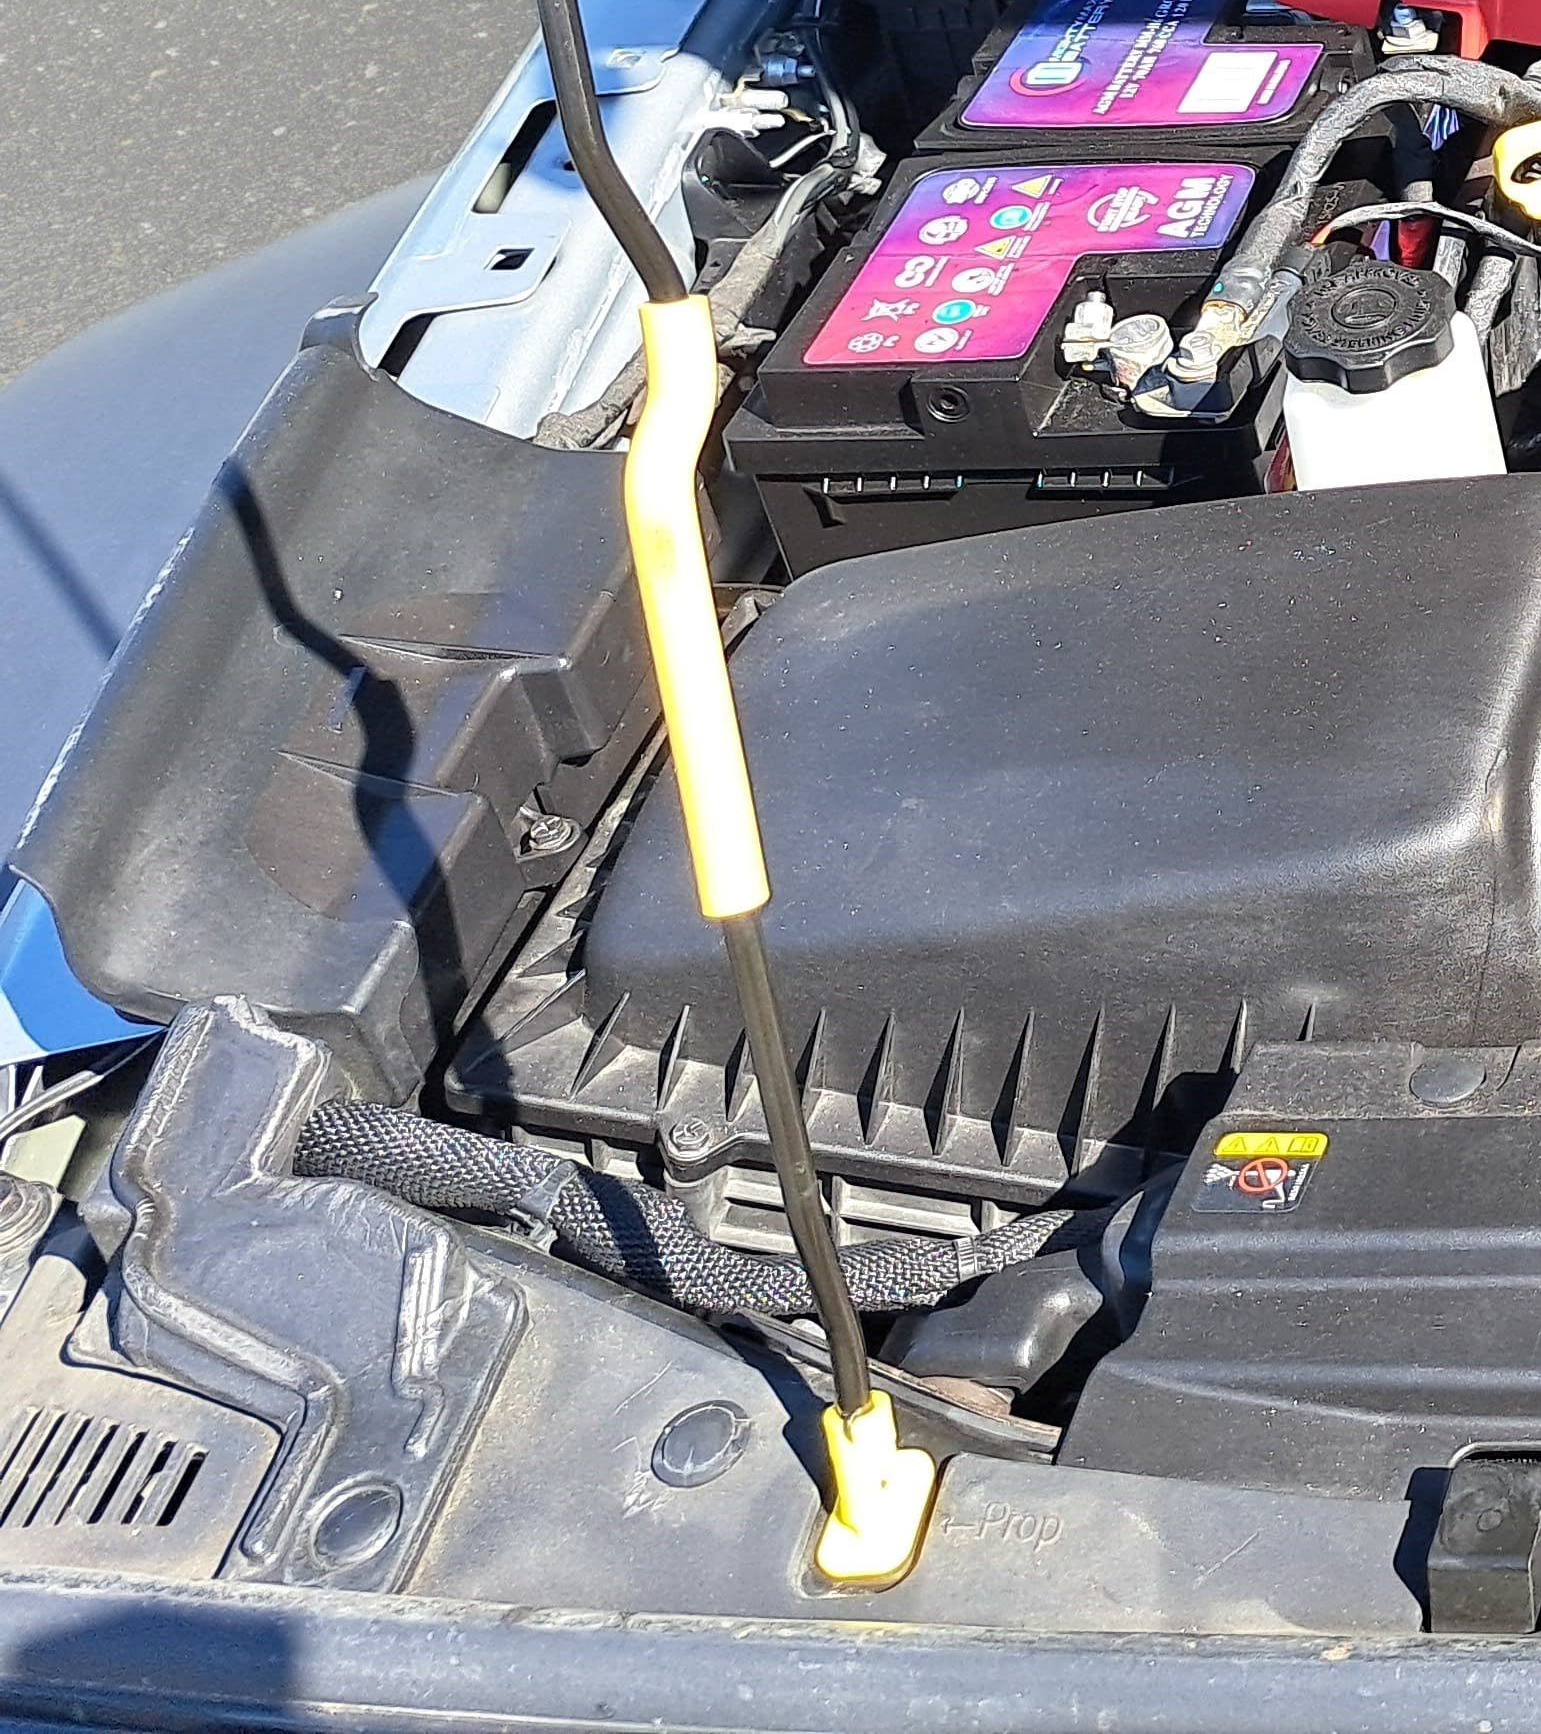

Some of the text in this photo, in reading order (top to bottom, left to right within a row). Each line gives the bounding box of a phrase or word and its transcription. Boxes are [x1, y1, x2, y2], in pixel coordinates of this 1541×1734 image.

[1155, 177, 1219, 236] AGM
[1193, 174, 1236, 237] TECHNOLOGY
[975, 1501, 1063, 1553] Prop
